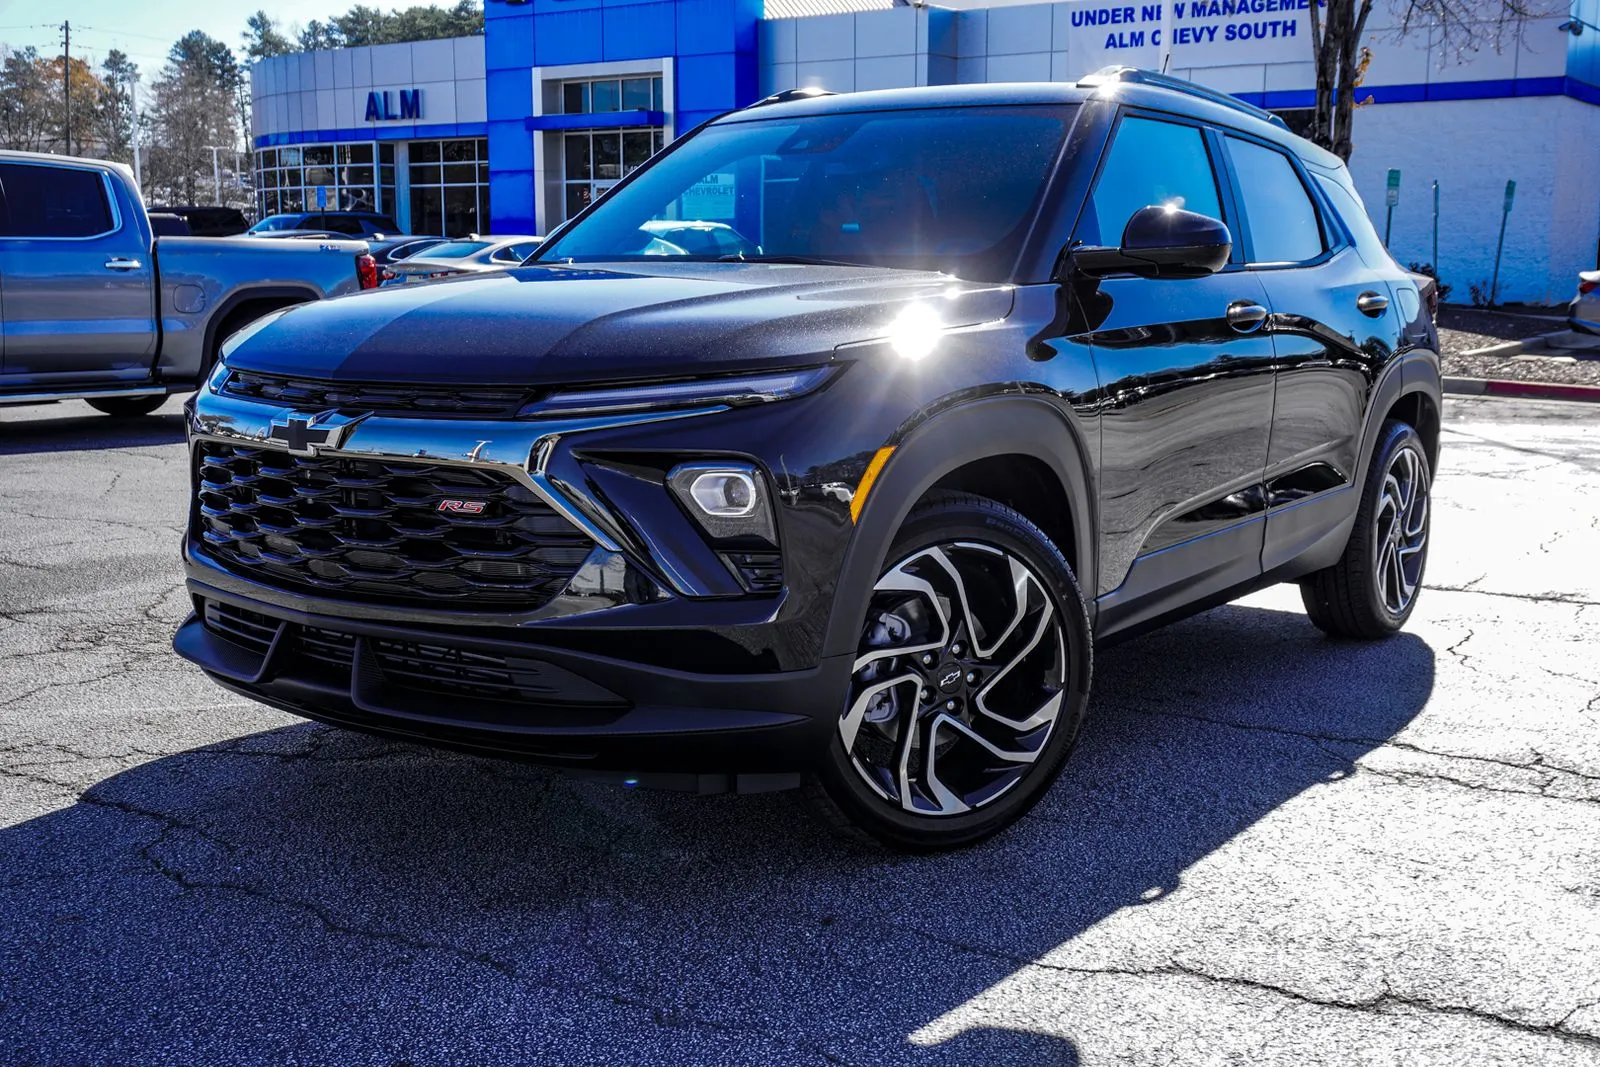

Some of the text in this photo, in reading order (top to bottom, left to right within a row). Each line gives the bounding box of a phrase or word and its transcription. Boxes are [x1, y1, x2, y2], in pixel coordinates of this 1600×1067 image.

[1071, 6, 1136, 27] UNDER
[1191, 0, 1326, 17] MANAGEME
[1105, 30, 1145, 50] ALM
[1224, 19, 1297, 42] SOUTH
[364, 88, 425, 121] ALM
[438, 499, 487, 513] RS
